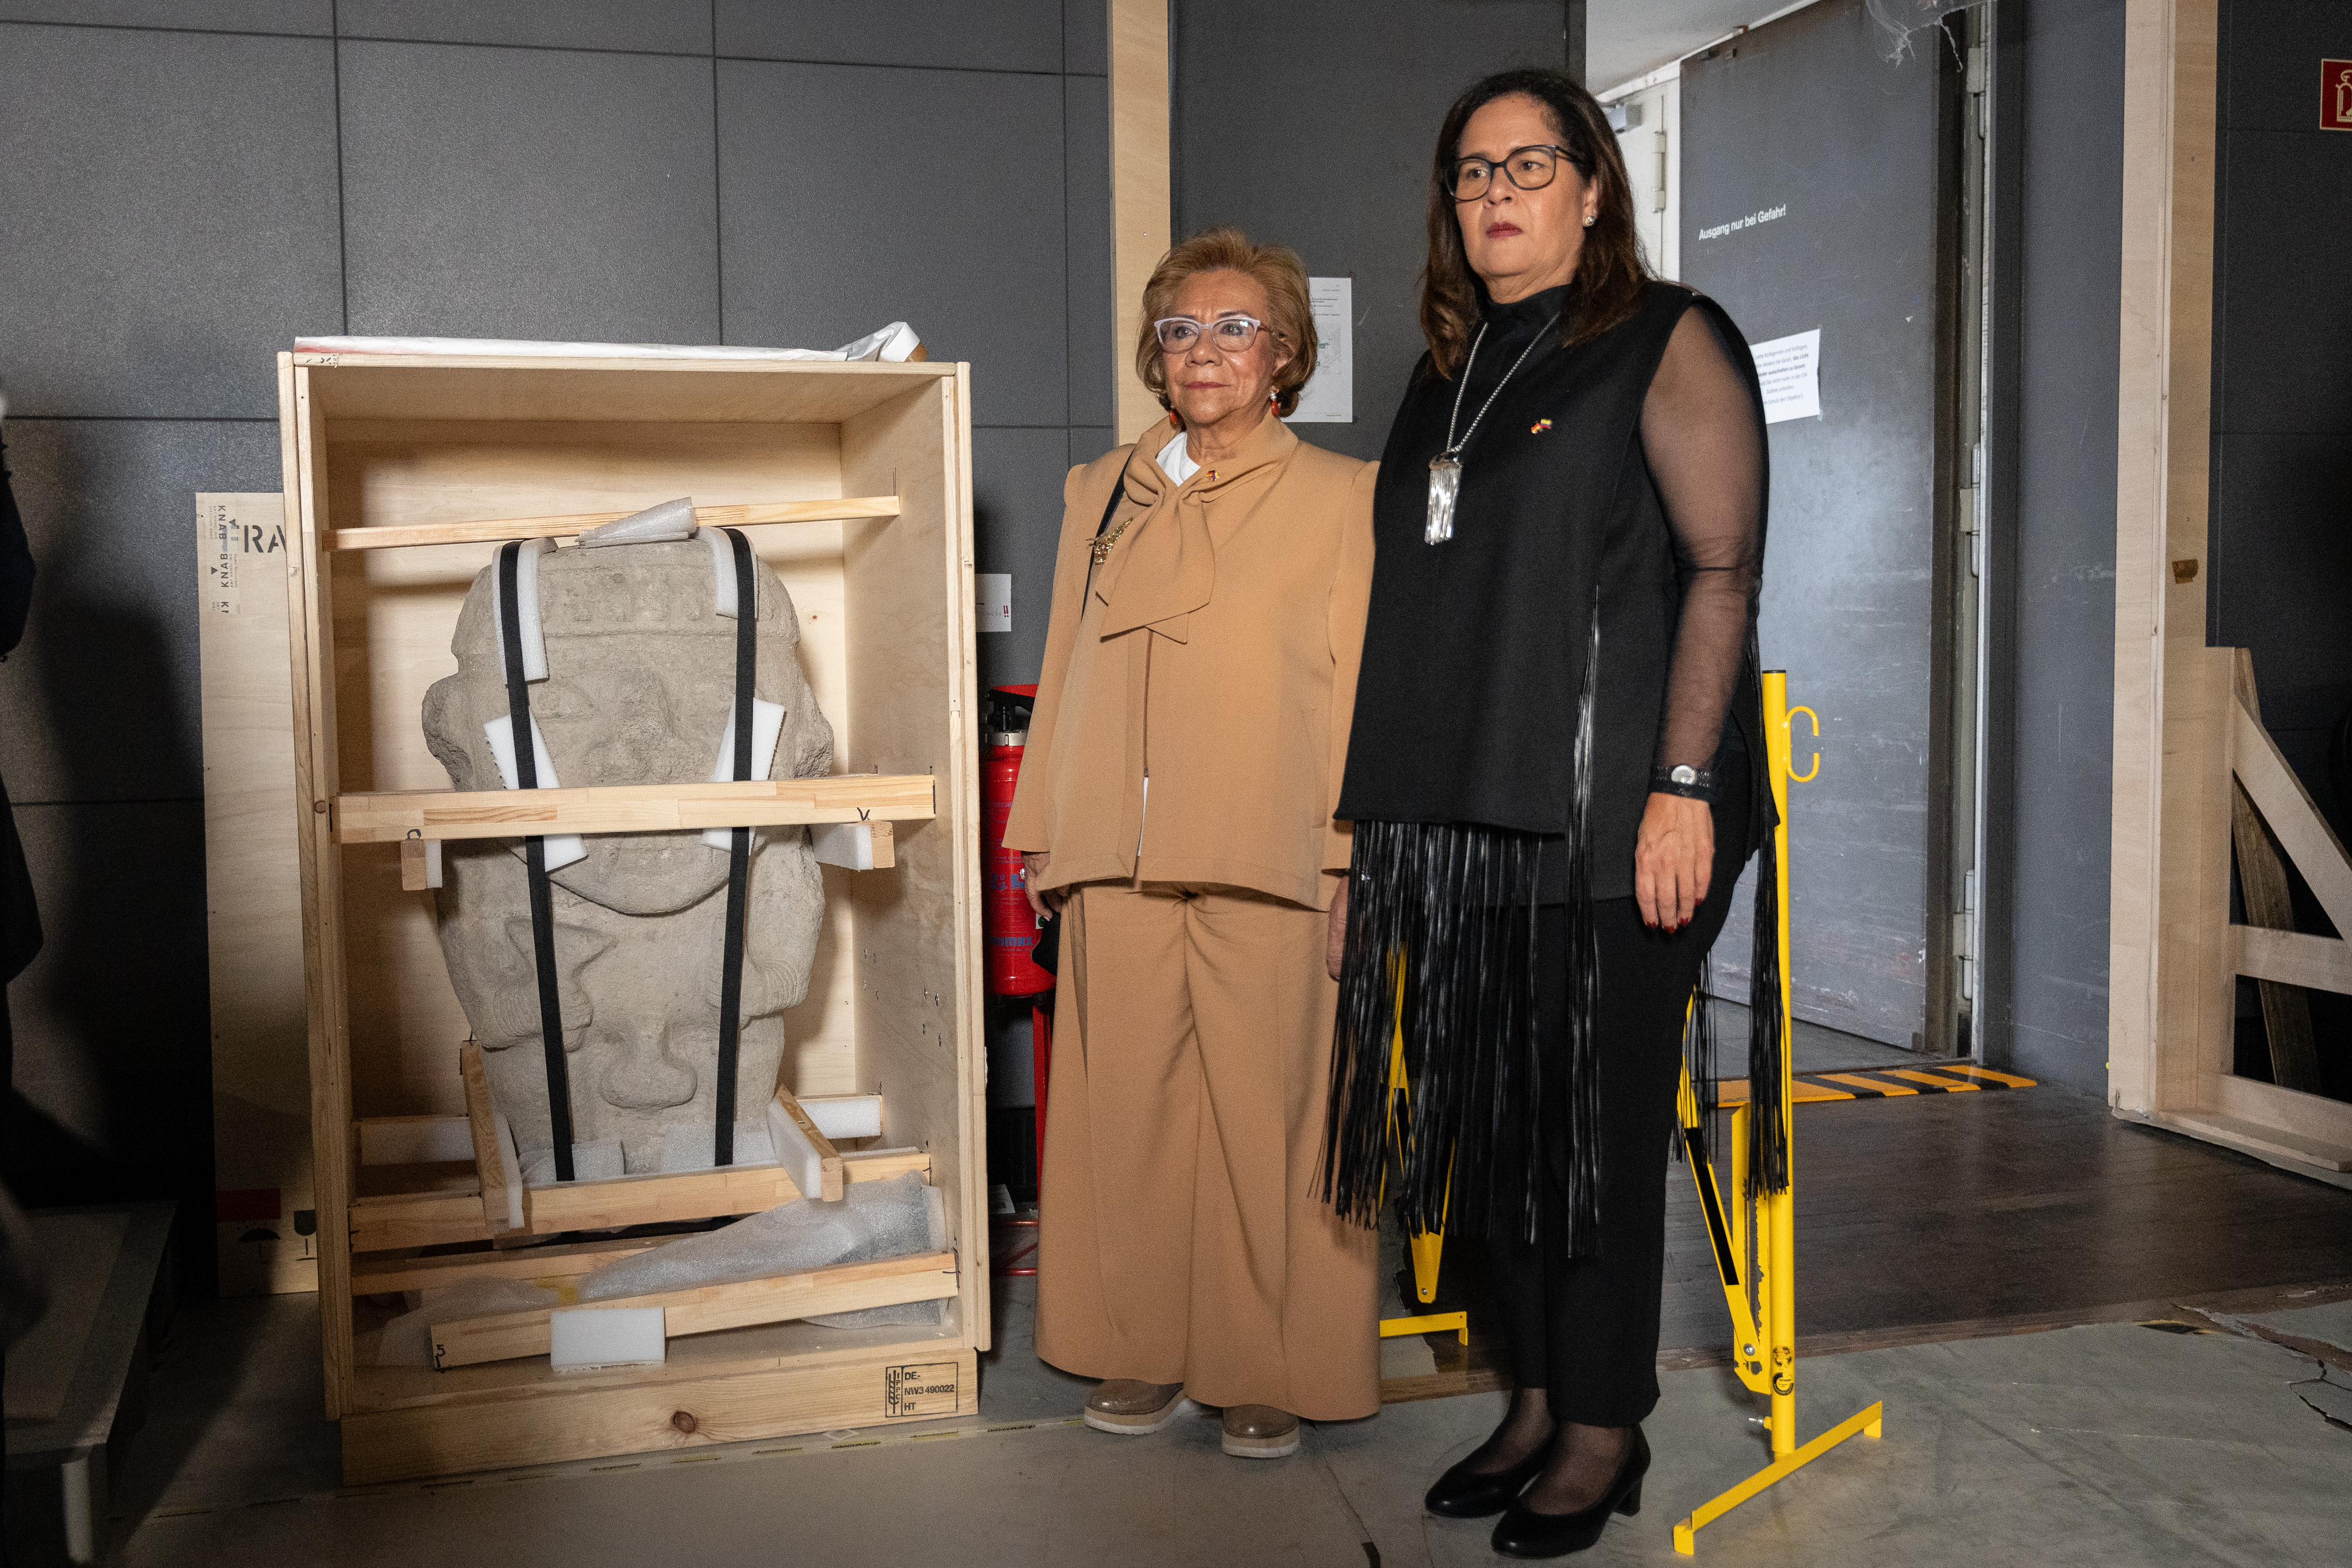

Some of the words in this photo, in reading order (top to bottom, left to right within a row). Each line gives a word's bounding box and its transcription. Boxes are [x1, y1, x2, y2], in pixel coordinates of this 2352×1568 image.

[1698, 223, 1729, 241] Ausgang
[1730, 219, 1743, 232] nur
[1745, 212, 1756, 227] bei
[1758, 203, 1786, 223] Gefahr!
[218, 505, 226, 540] KNAB
[220, 553, 229, 588] KNAB
[904, 1371, 921, 1380] DE-
[904, 1386, 924, 1395] NW3
[925, 1384, 955, 1394] 490022
[904, 1402, 916, 1410] HT
